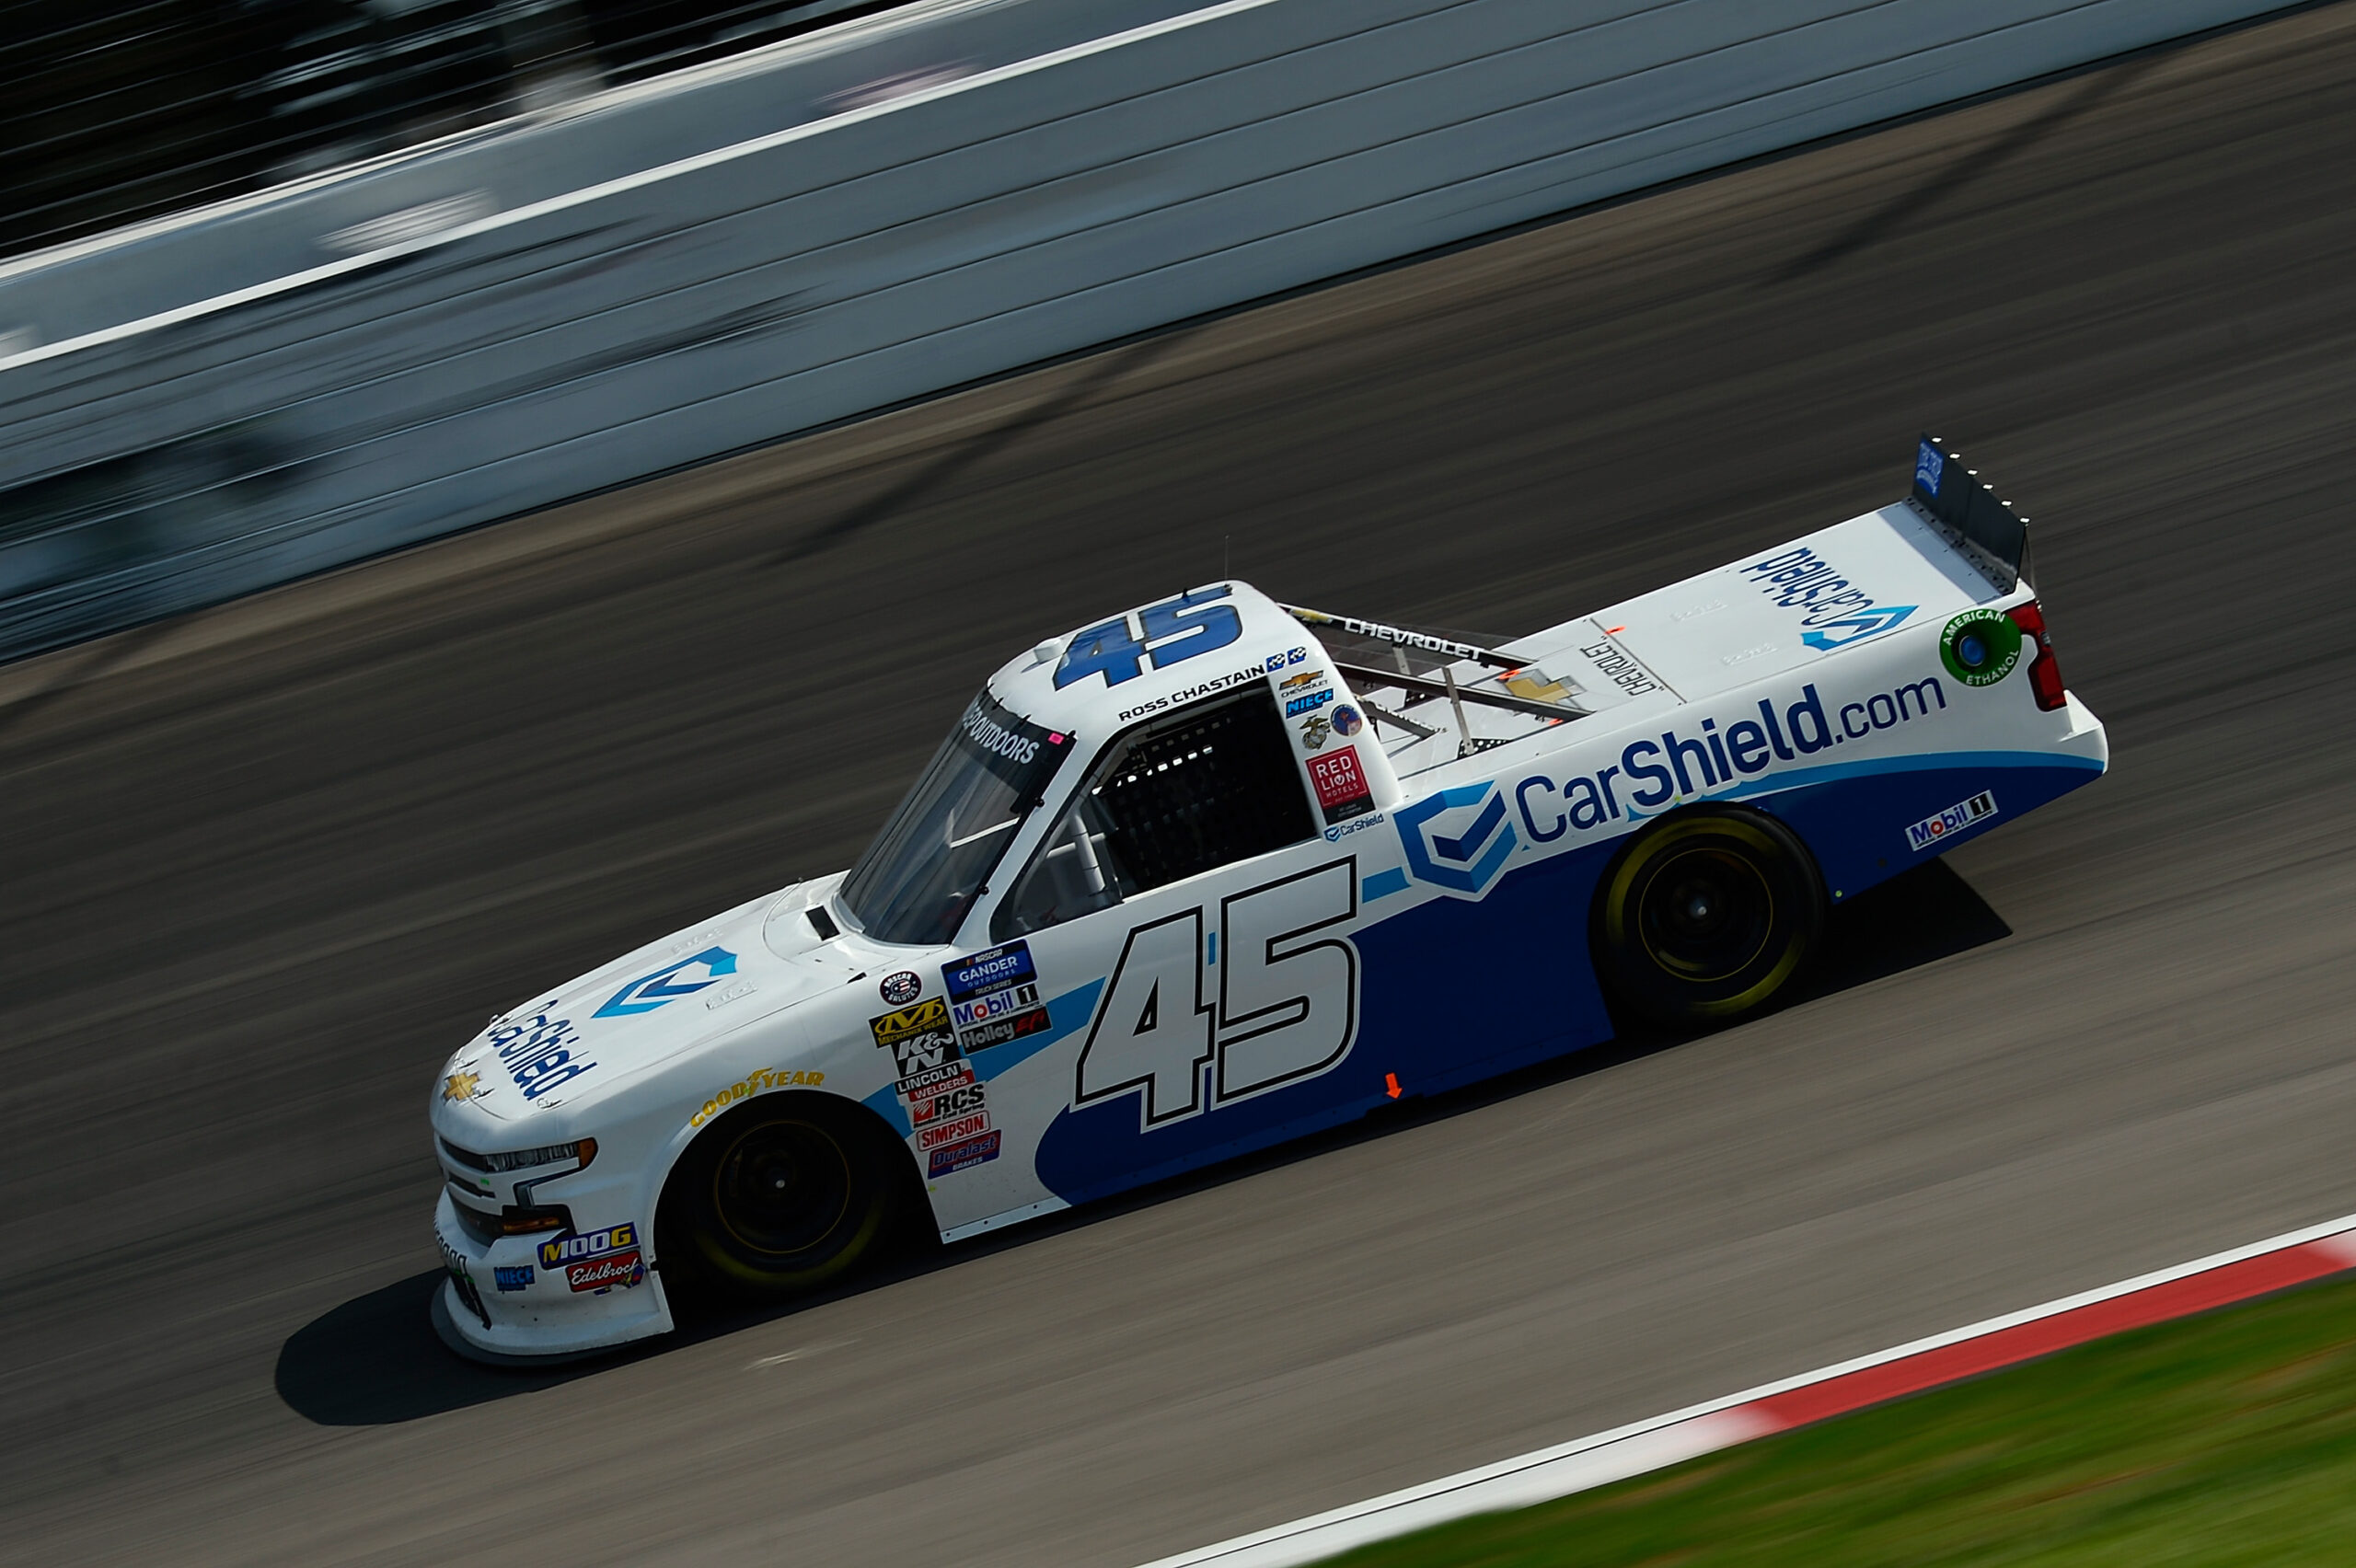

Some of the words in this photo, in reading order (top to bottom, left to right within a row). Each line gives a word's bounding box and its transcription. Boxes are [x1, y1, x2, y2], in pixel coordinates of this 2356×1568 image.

[1739, 547, 1874, 626] CarShield
[1052, 583, 1242, 692] 45
[1345, 617, 1485, 660] CHEVROLET
[1942, 609, 2006, 646] AMERICAN
[1579, 641, 1657, 697] CHEVROLET
[1965, 649, 2019, 686] ETHANOL
[1118, 697, 1169, 721] ROSS
[1171, 663, 1266, 703] CHASTAIN
[1280, 679, 1329, 698] CHEVROLET
[1287, 689, 1334, 714] NIECE
[969, 716, 1040, 764] OUTDOORS
[1315, 755, 1352, 778] RED
[1515, 676, 1947, 843] CarShield.com
[1321, 770, 1357, 791] LION
[1326, 782, 1359, 799] HOTELS
[1340, 813, 1385, 836] CarShield
[1910, 803, 1969, 845] Mobil
[958, 956, 1018, 983] GANDER
[975, 948, 1003, 964] NASCAR
[884, 973, 913, 988] NASCAR
[967, 968, 1016, 987] OUTDOORS
[975, 985, 993, 996] TRUCK
[992, 978, 1012, 990] SERIES
[1072, 853, 1358, 1128] 45
[887, 986, 918, 1002] SALUTES
[953, 990, 1014, 1025] Mobil
[877, 1027, 923, 1046] MECHANIX
[923, 1016, 949, 1031] WEAR
[962, 1022, 1015, 1048] Holley
[487, 999, 597, 1101] CaShield
[897, 1065, 959, 1093] LINCOLN
[915, 1076, 968, 1099] WELDERS
[690, 1067, 826, 1127] GOODYEAR
[934, 1084, 985, 1116] RCS
[921, 1114, 985, 1148] SIMPSON
[932, 1136, 997, 1168] Duralast
[953, 1156, 983, 1171] BRAKES
[543, 1226, 632, 1263] MOOG
[497, 1266, 534, 1286] NIECE
